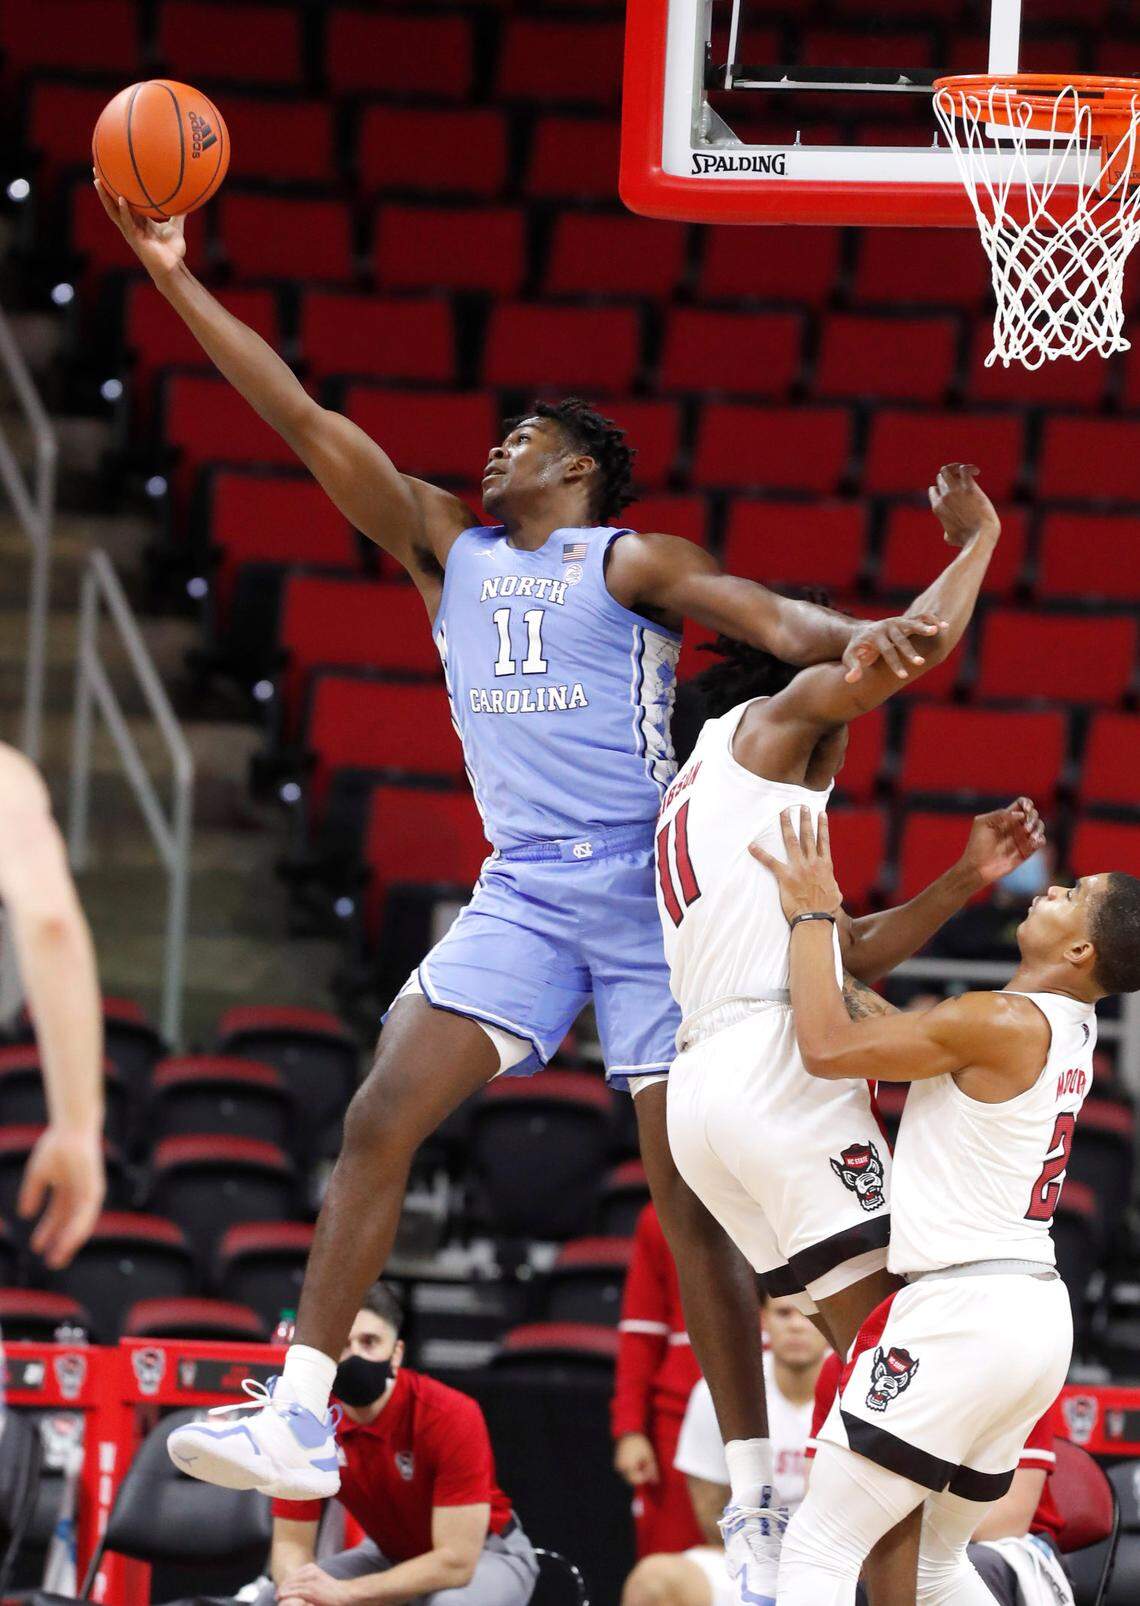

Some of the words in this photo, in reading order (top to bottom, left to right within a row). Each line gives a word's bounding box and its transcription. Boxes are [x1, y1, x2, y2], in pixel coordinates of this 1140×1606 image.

[189, 111, 201, 159] adidas
[691, 153, 785, 175] SPALDING
[480, 575, 569, 606] NORTH
[492, 607, 549, 677] 11
[469, 682, 589, 714] CAROLINA
[656, 797, 702, 928] 11
[1023, 1111, 1077, 1222] 2
